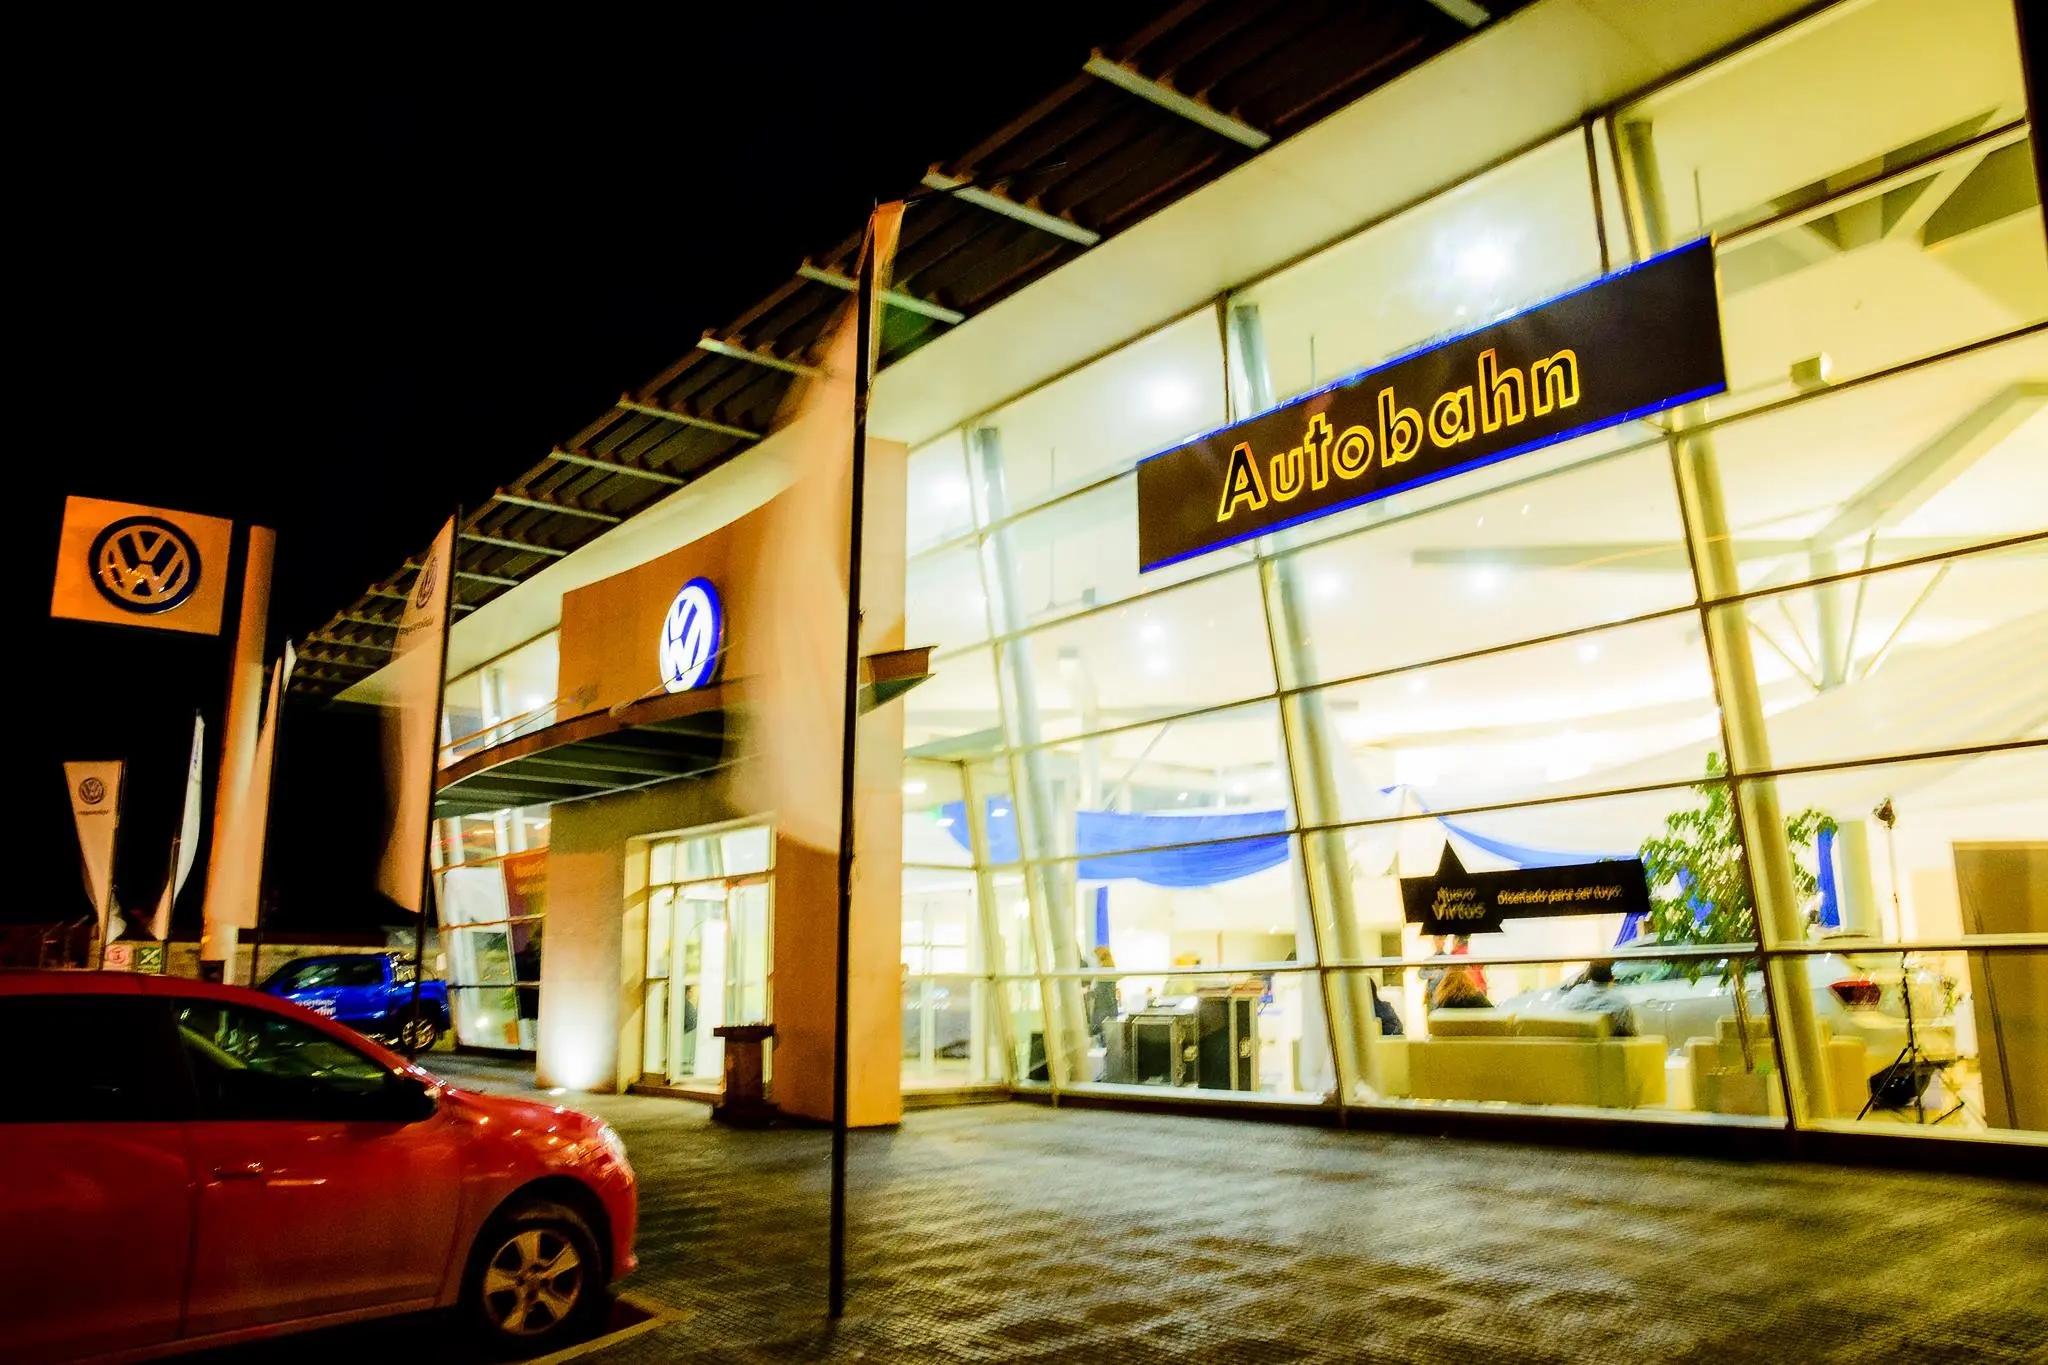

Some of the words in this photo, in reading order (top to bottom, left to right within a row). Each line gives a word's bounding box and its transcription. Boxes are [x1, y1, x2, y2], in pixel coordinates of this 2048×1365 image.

[1218, 349, 1580, 522] Autobahn
[1548, 888, 1574, 905] para
[1431, 901, 1486, 921] Virtus
